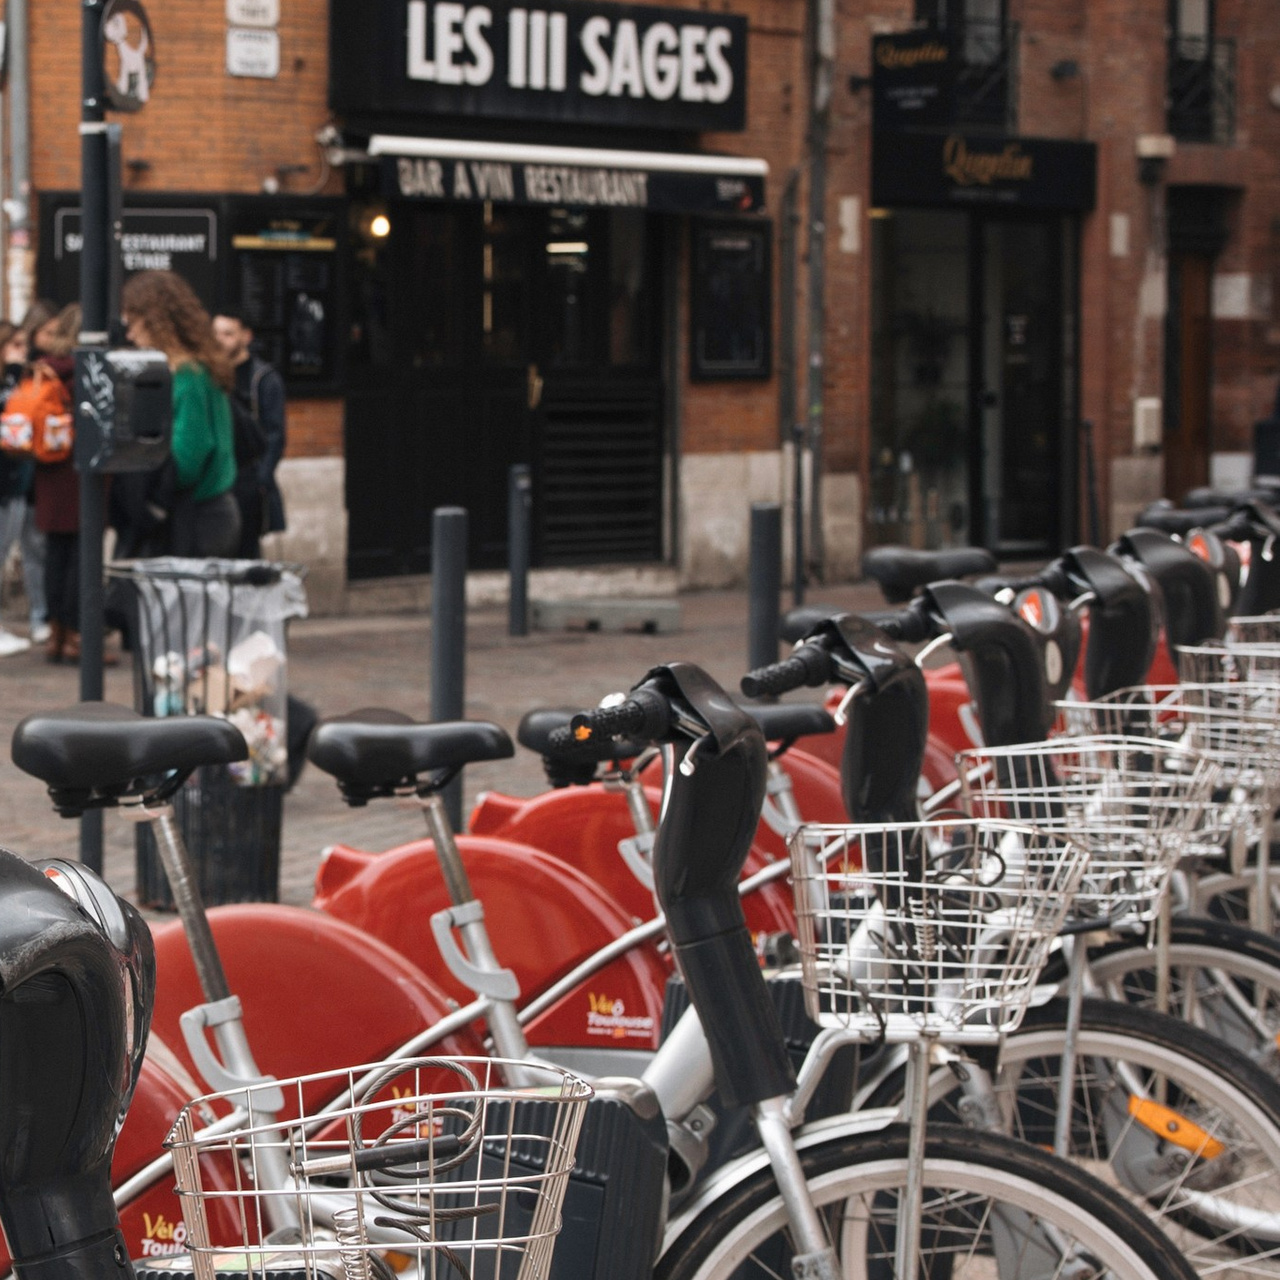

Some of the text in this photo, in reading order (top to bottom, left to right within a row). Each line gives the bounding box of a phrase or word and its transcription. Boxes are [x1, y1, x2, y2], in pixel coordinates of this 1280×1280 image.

[406, 0, 733, 104] LES III SAGES
[396, 157, 444, 197] BAR
[472, 162, 515, 201] VIN
[524, 164, 649, 207] RESTAURANT
